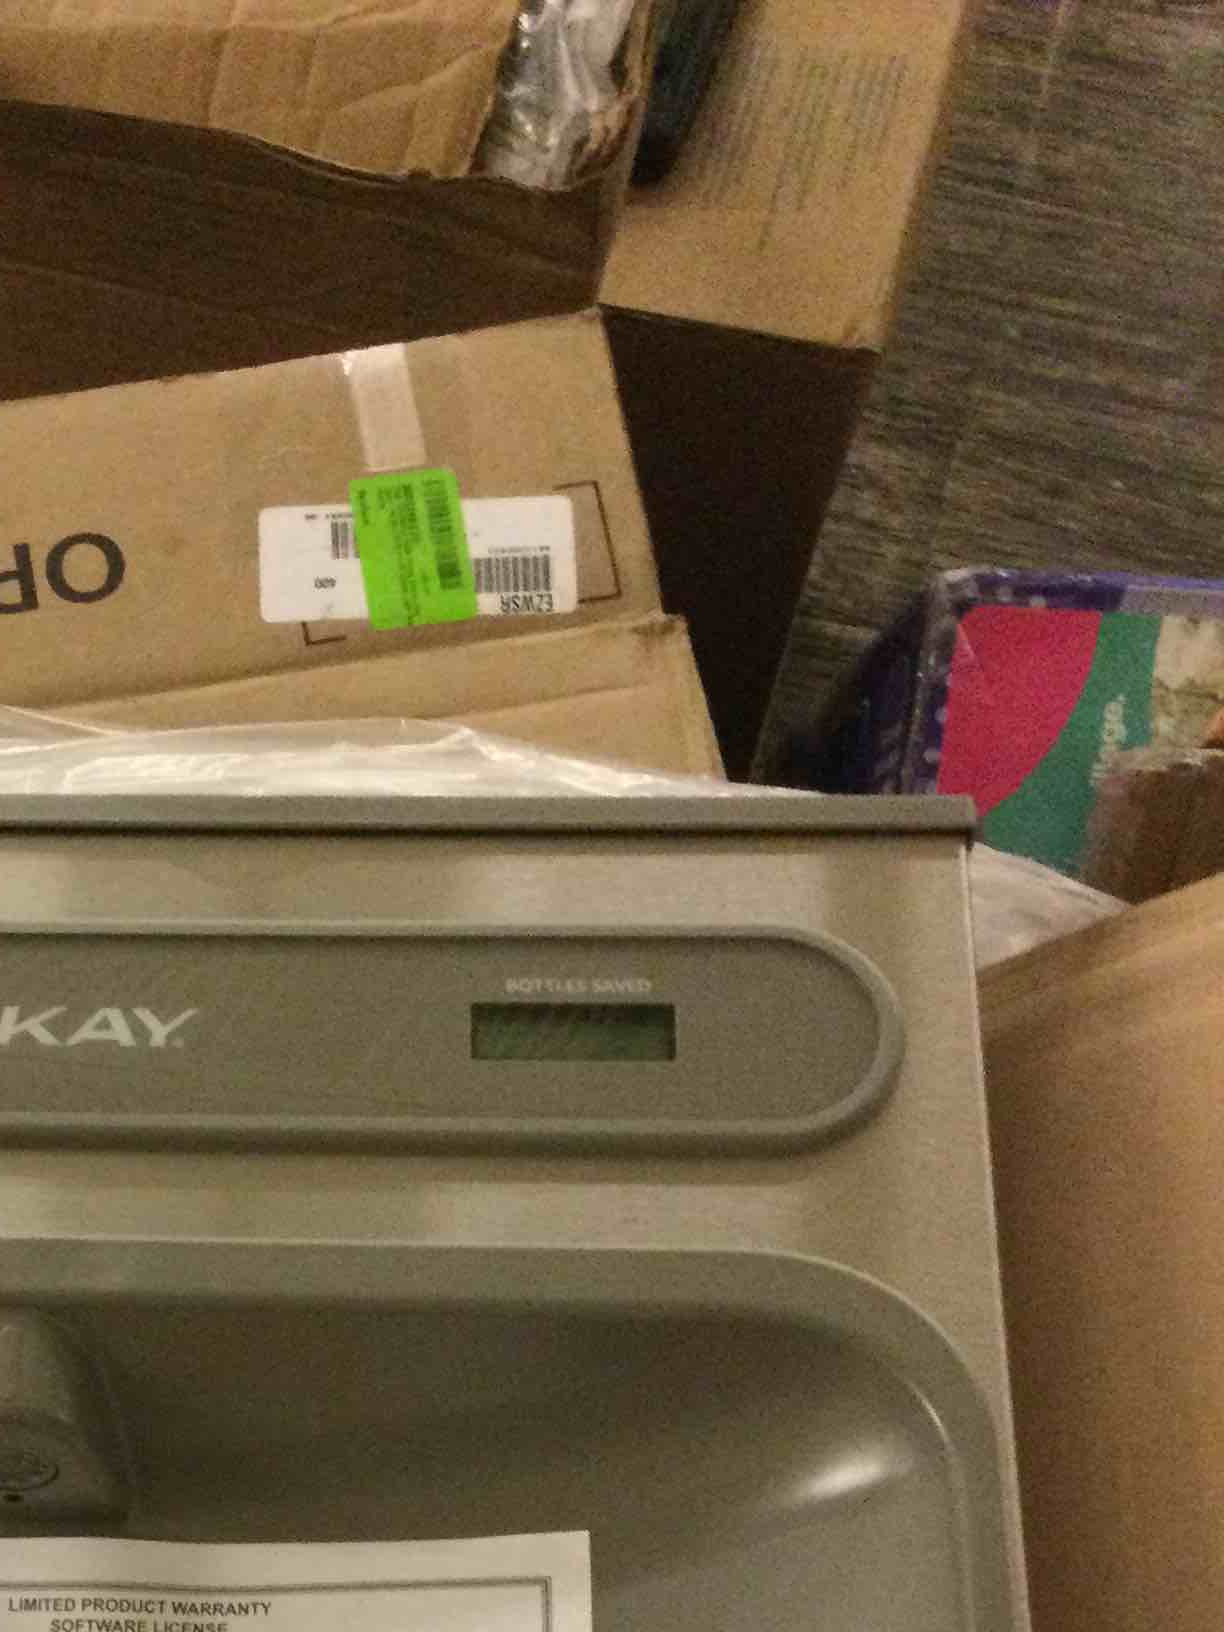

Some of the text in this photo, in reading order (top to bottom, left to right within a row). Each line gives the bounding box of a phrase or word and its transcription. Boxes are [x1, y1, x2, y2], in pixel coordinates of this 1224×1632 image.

[505, 978, 653, 994] BOTTLES SAVED
[8, 1596, 272, 1617] LIMITED PRODUCT WARRANTY
